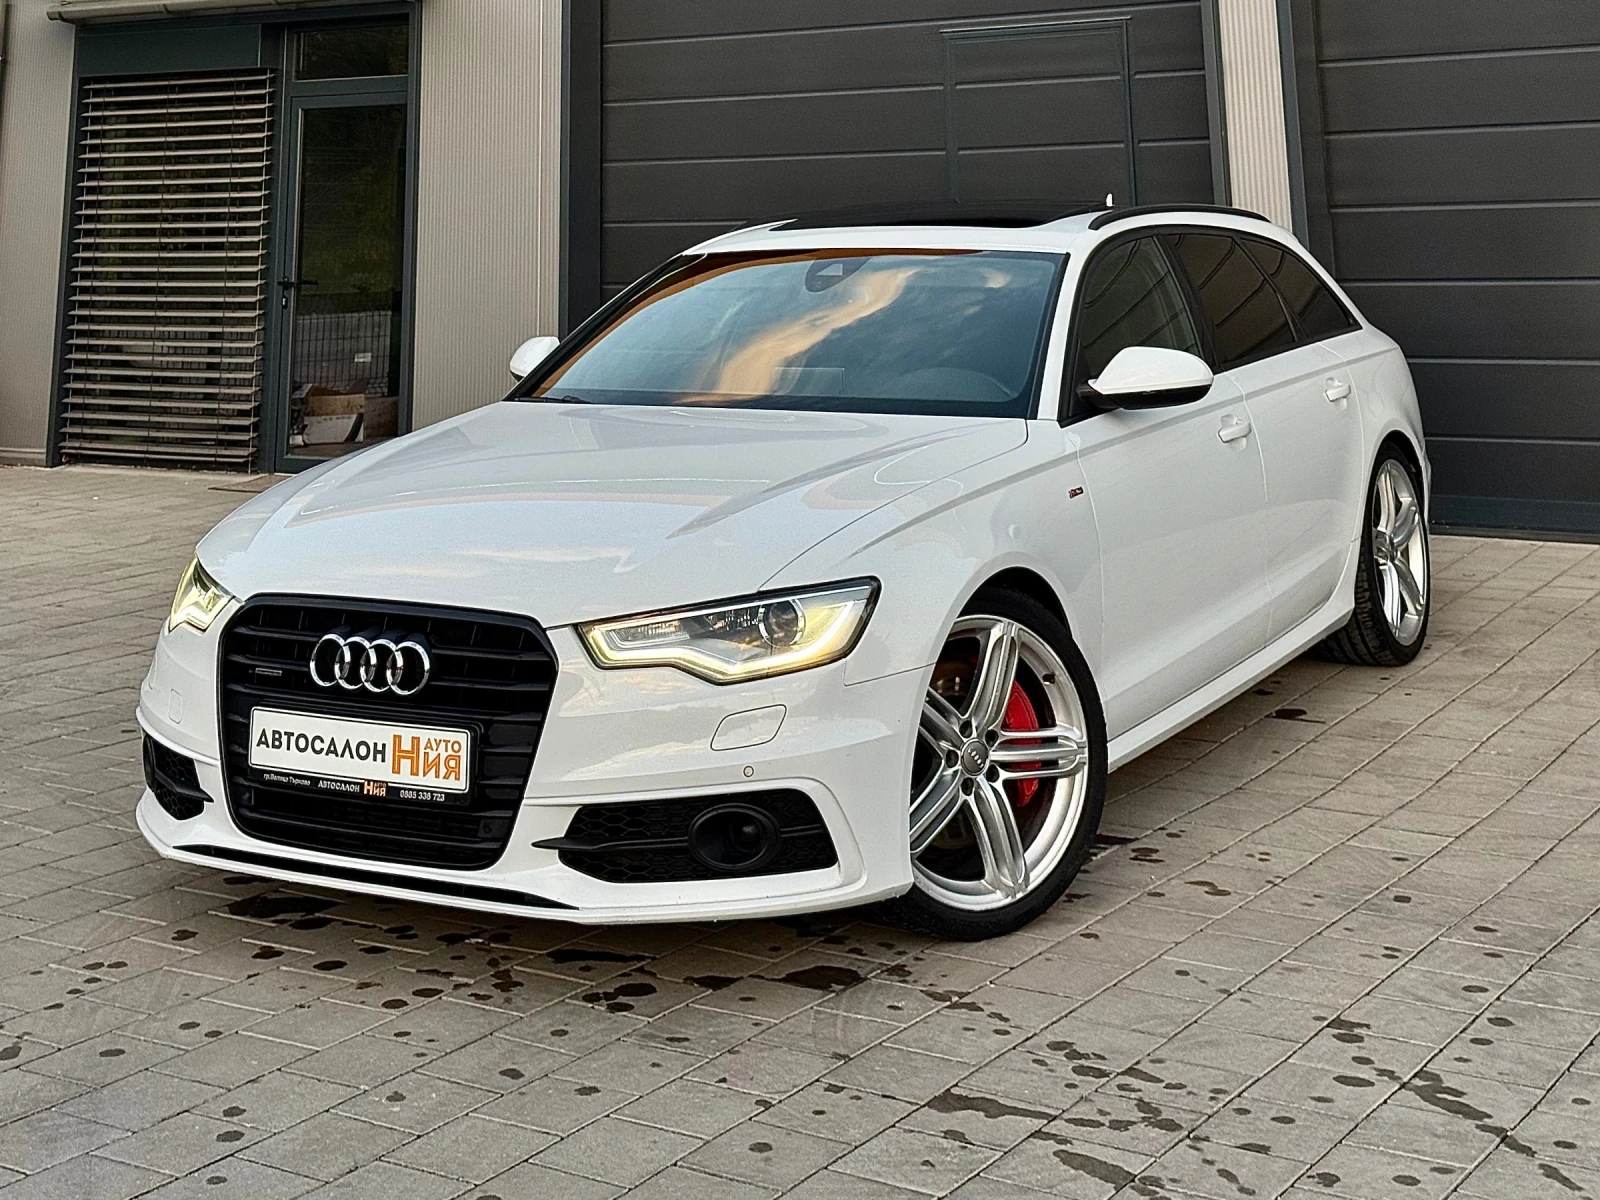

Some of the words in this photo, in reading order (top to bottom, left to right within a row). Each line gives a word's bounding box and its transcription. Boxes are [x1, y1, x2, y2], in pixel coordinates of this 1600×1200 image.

[256, 728, 387, 763] АВТОСАЛОН
[423, 738, 462, 754] АУТО
[318, 780, 360, 793] АВТОСАЛОН
[433, 793, 445, 802] 723
